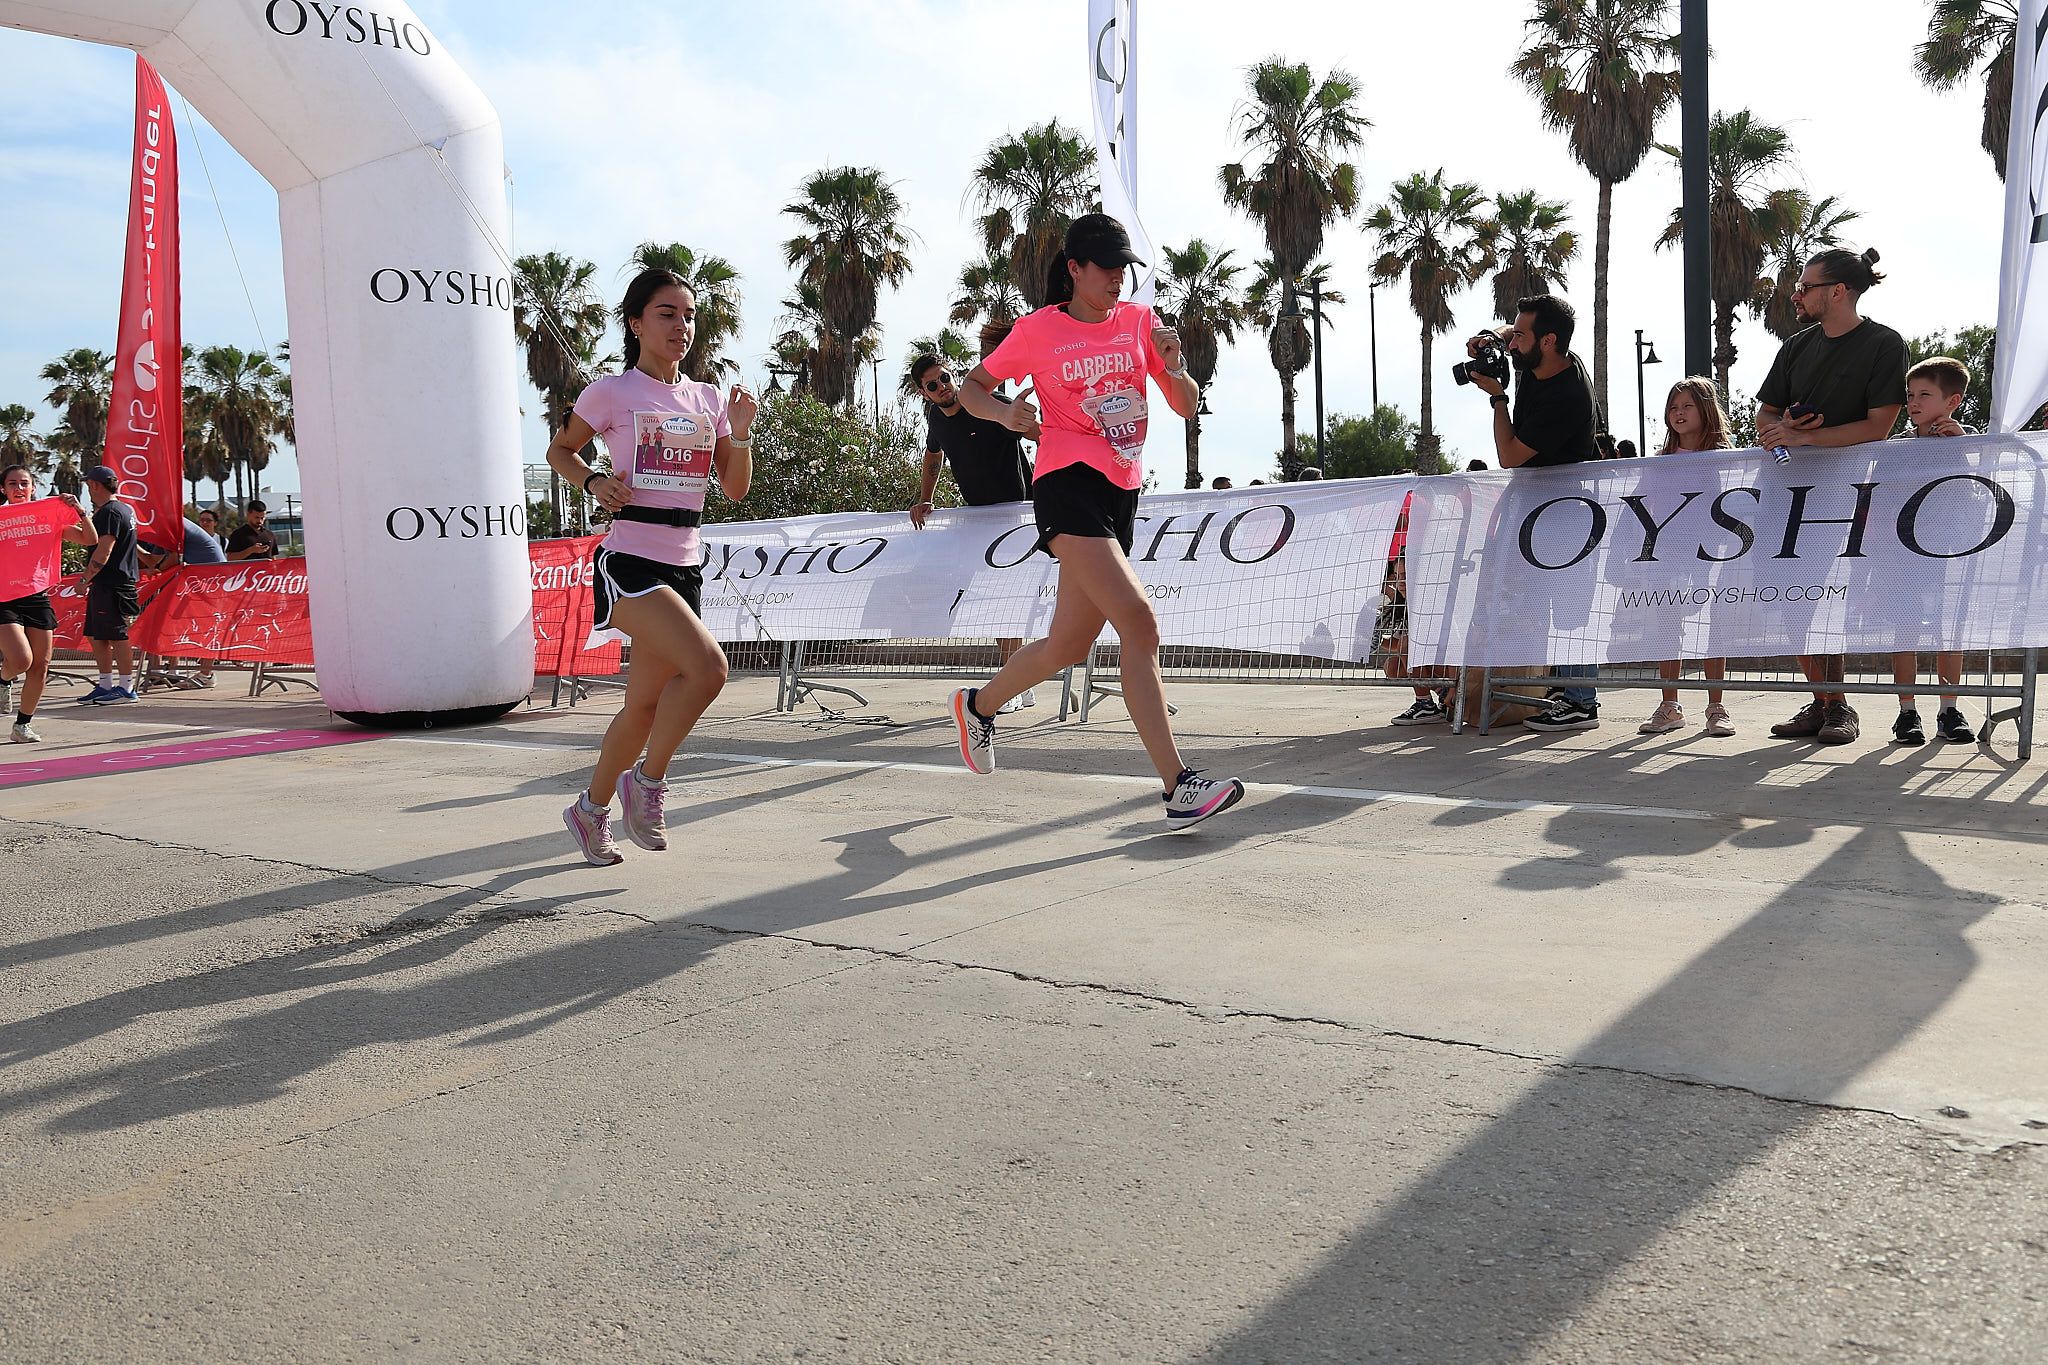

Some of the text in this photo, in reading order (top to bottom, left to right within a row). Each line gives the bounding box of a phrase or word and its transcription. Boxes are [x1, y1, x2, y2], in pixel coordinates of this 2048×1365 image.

[265, 0, 431, 56] OYSHO
[370, 268, 511, 311] OYSHO
[1054, 341, 1087, 355] OYSHO
[1109, 422, 1137, 438] 016
[663, 448, 692, 461] 016
[642, 478, 670, 486] OYSHO
[0, 514, 36, 529] SOMOS
[386, 503, 524, 541] OYSHO
[1518, 474, 2016, 570] OYSHO
[984, 504, 1296, 568] OHO
[243, 570, 309, 594] Santa
[1621, 584, 1847, 609] WWW.OYSHO.COM
